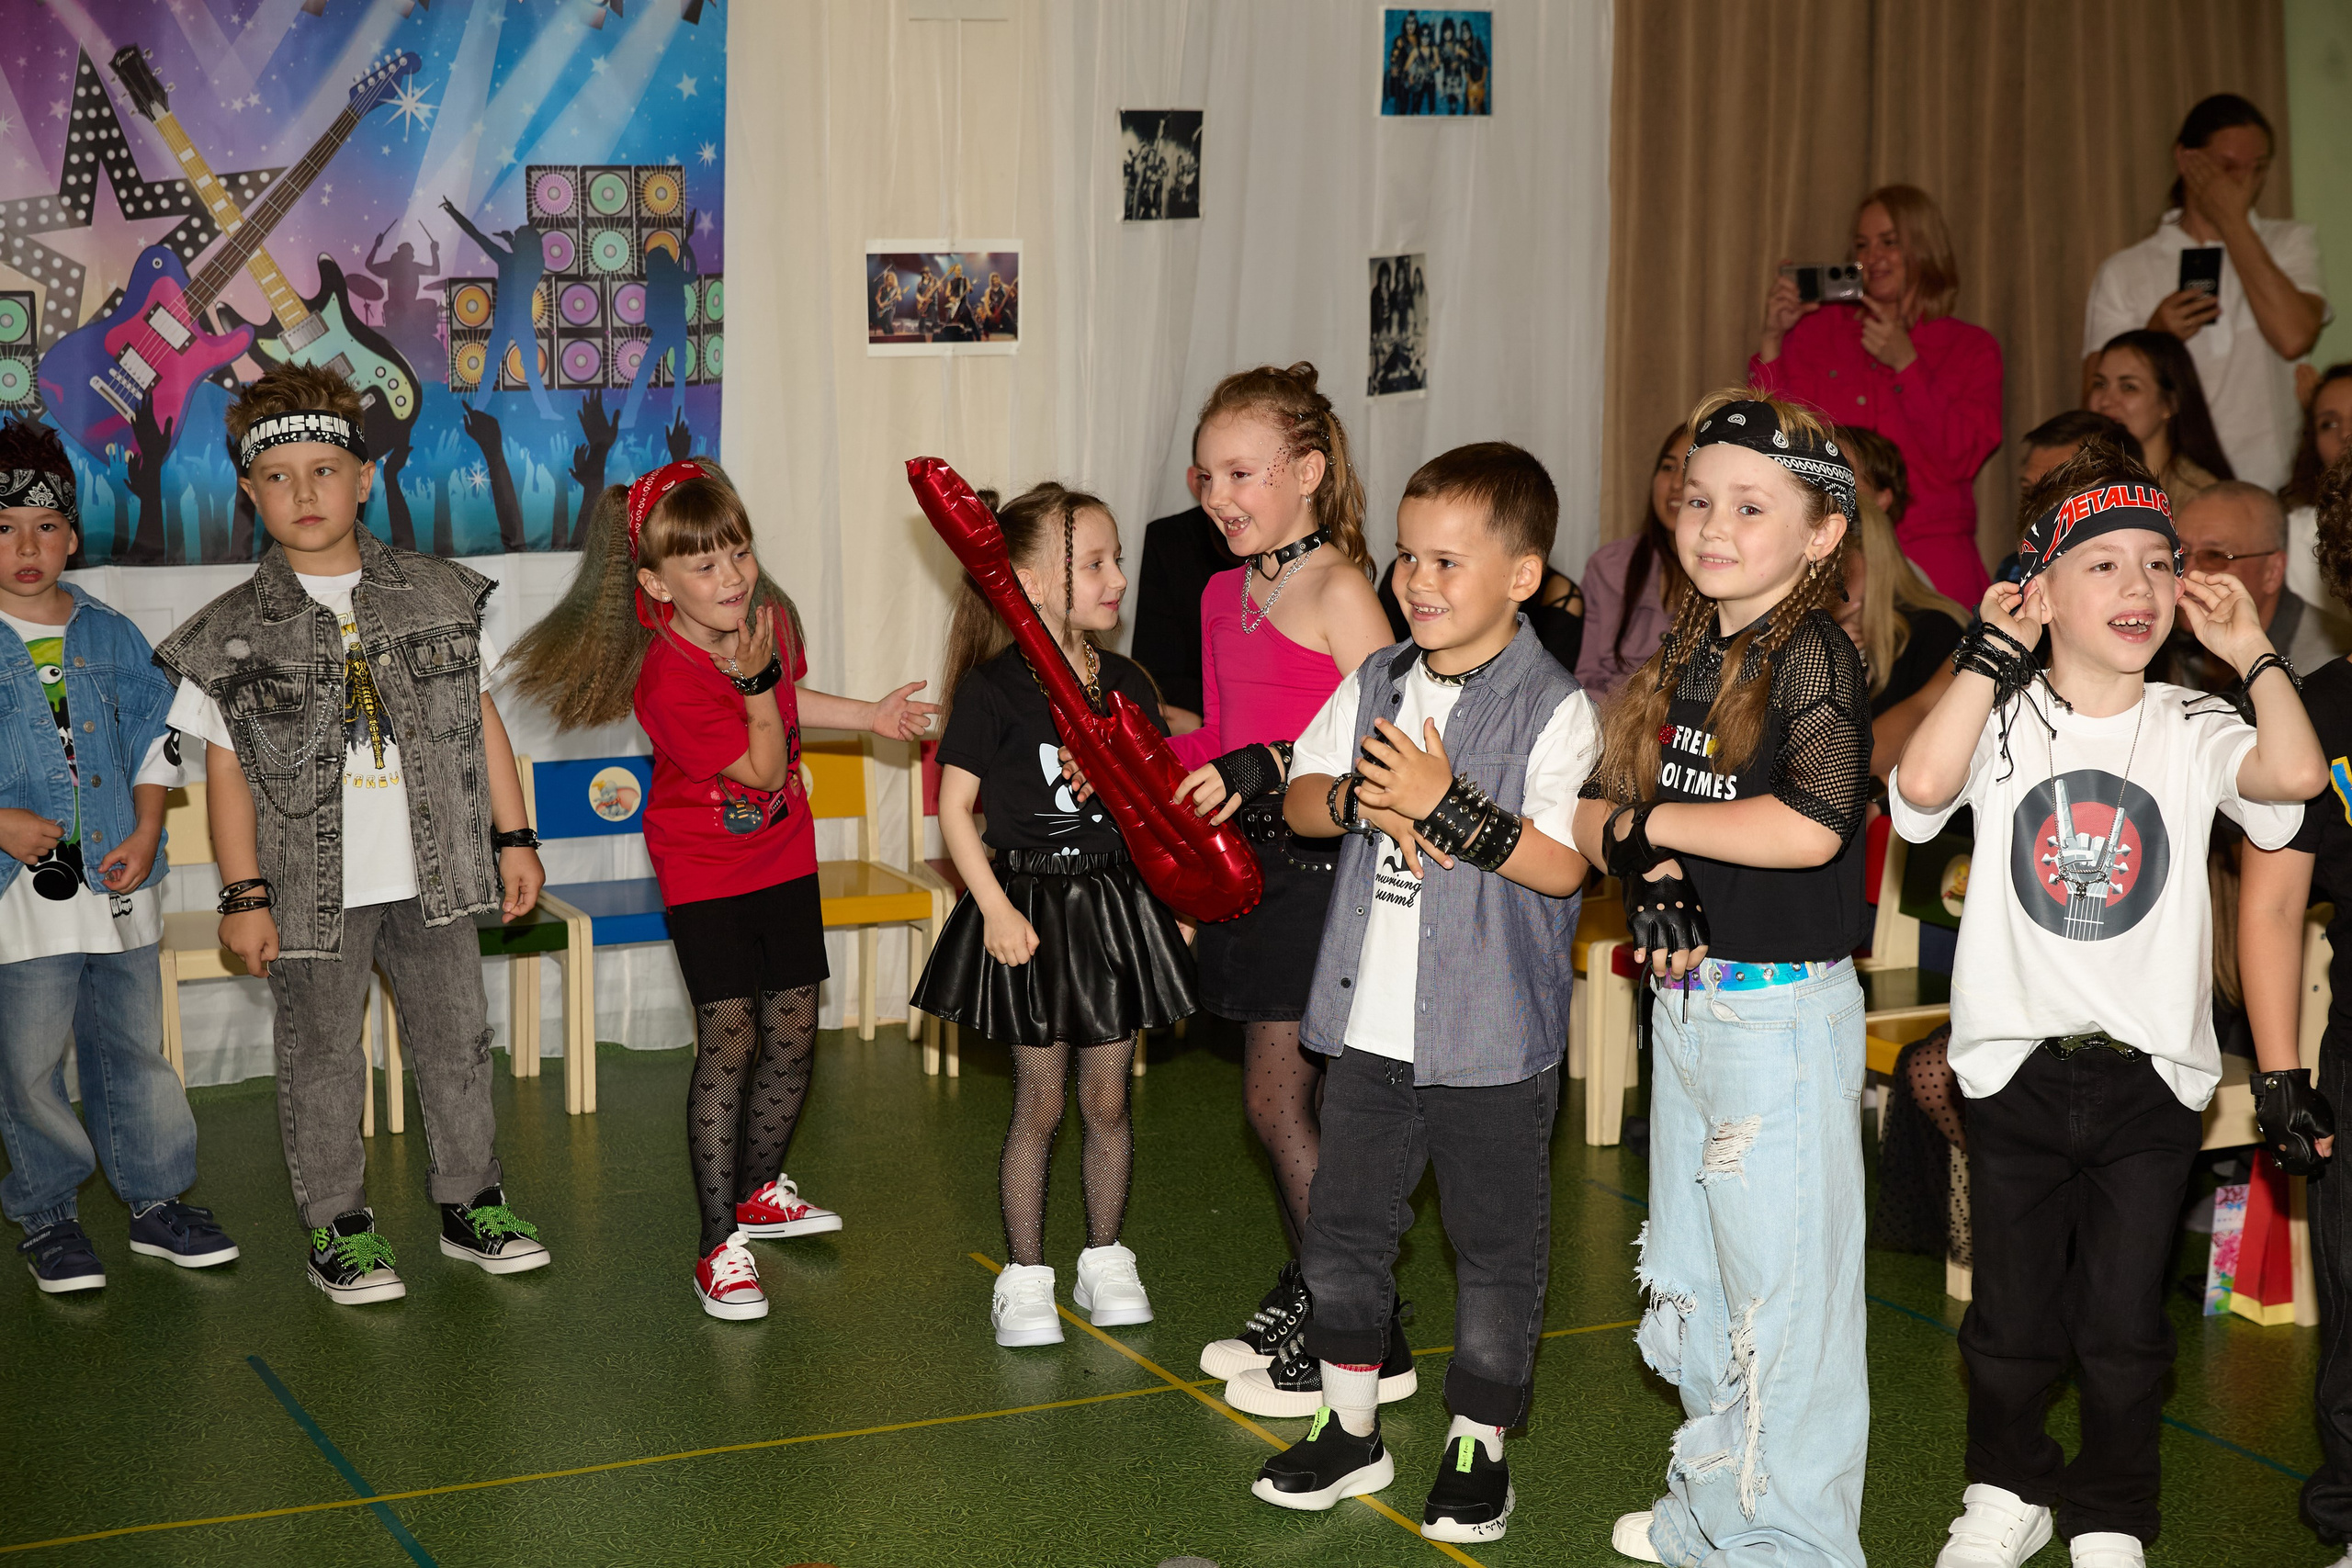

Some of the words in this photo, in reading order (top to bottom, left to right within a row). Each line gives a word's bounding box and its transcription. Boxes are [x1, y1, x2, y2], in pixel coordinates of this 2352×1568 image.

[240, 414, 350, 456] AMMSTEIN
[2042, 485, 2178, 563] METALLIC
[343, 771, 402, 789] FOREV
[1683, 767, 1737, 801] TIMES
